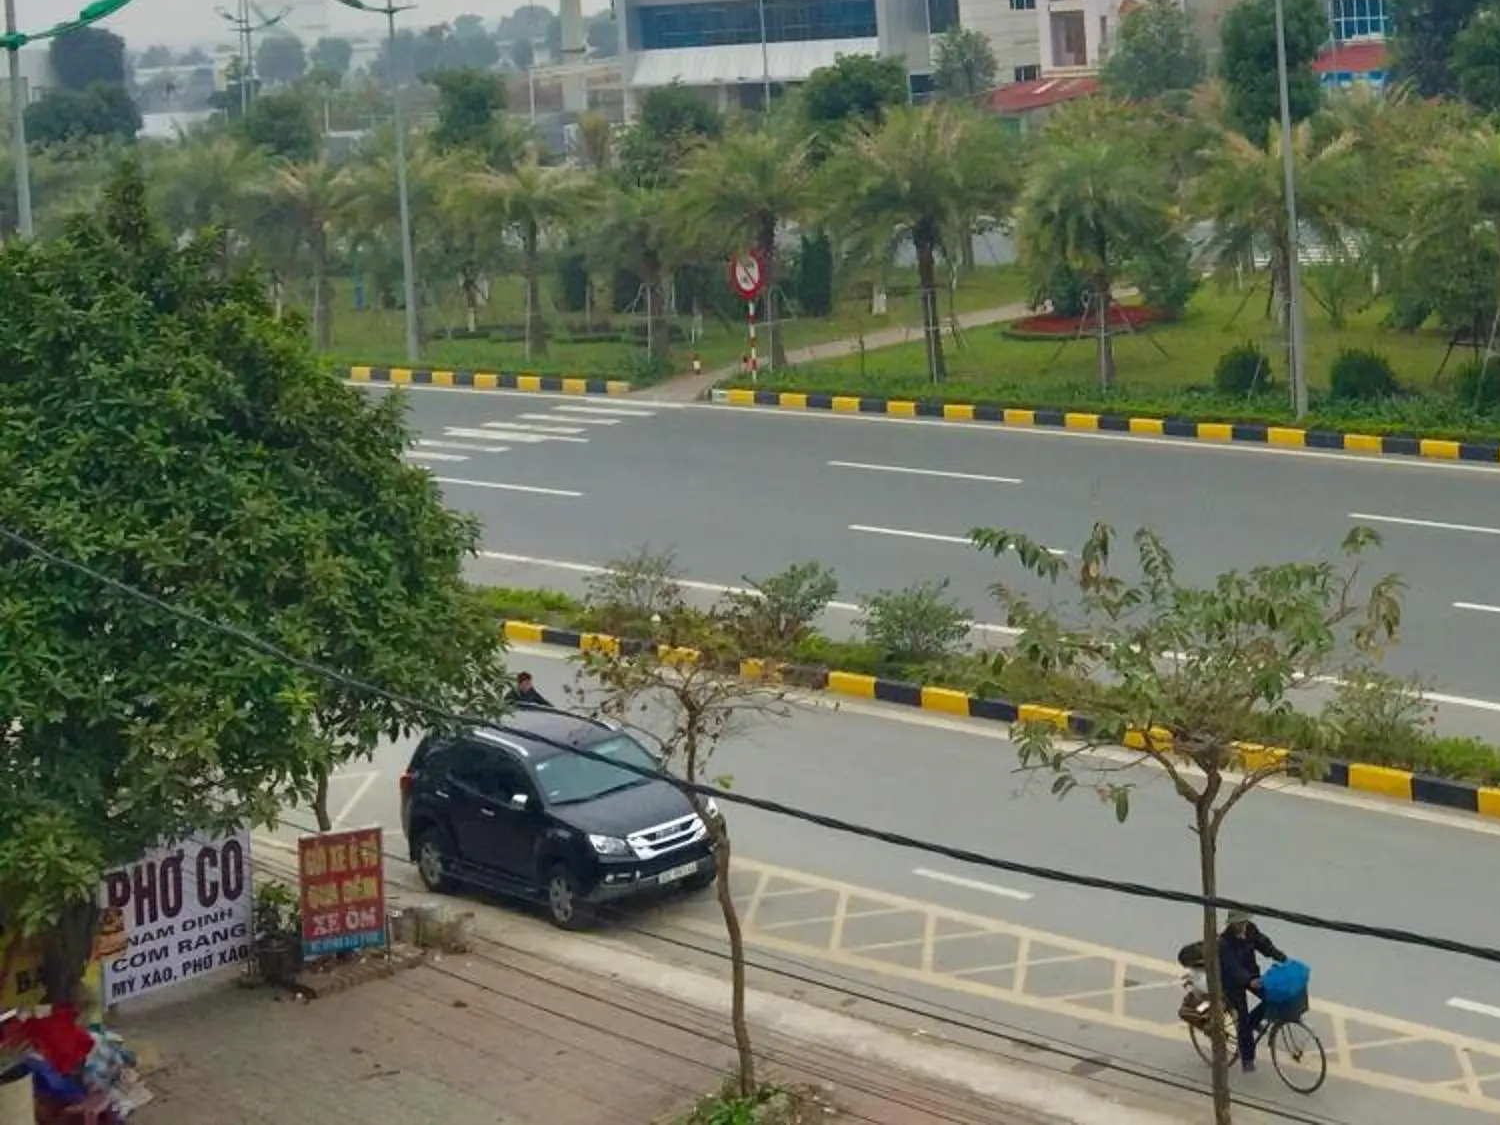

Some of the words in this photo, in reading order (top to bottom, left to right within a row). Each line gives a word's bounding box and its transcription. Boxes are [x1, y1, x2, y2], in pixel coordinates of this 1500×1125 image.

[126, 925, 175, 947] NAM
[312, 912, 341, 936] XE
[111, 945, 169, 974] CƠM
[177, 923, 247, 955] RANG
